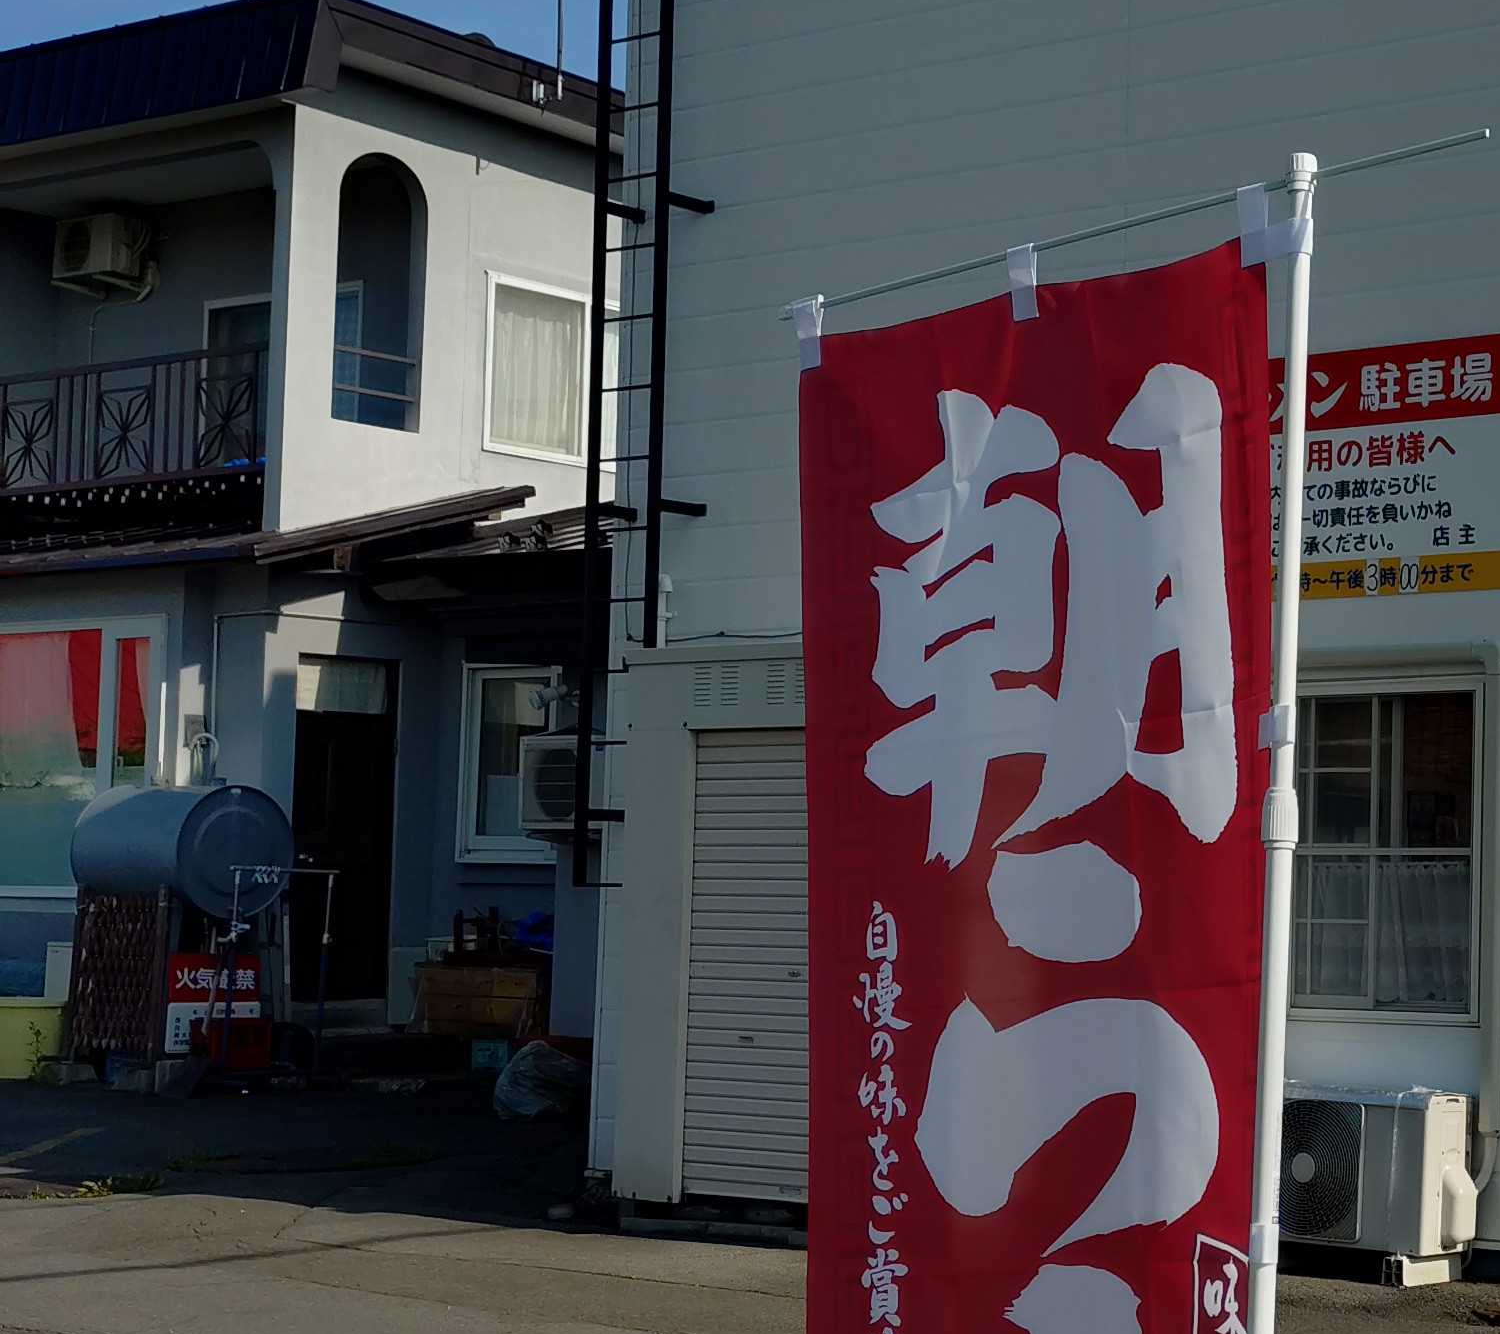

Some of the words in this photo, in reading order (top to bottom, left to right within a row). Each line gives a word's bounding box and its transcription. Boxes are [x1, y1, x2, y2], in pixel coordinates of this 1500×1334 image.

[1359, 353, 1494, 413] 駐車場
[1271, 430, 1456, 472] 用の皆様へ
[1432, 524, 1476, 547] 店主
